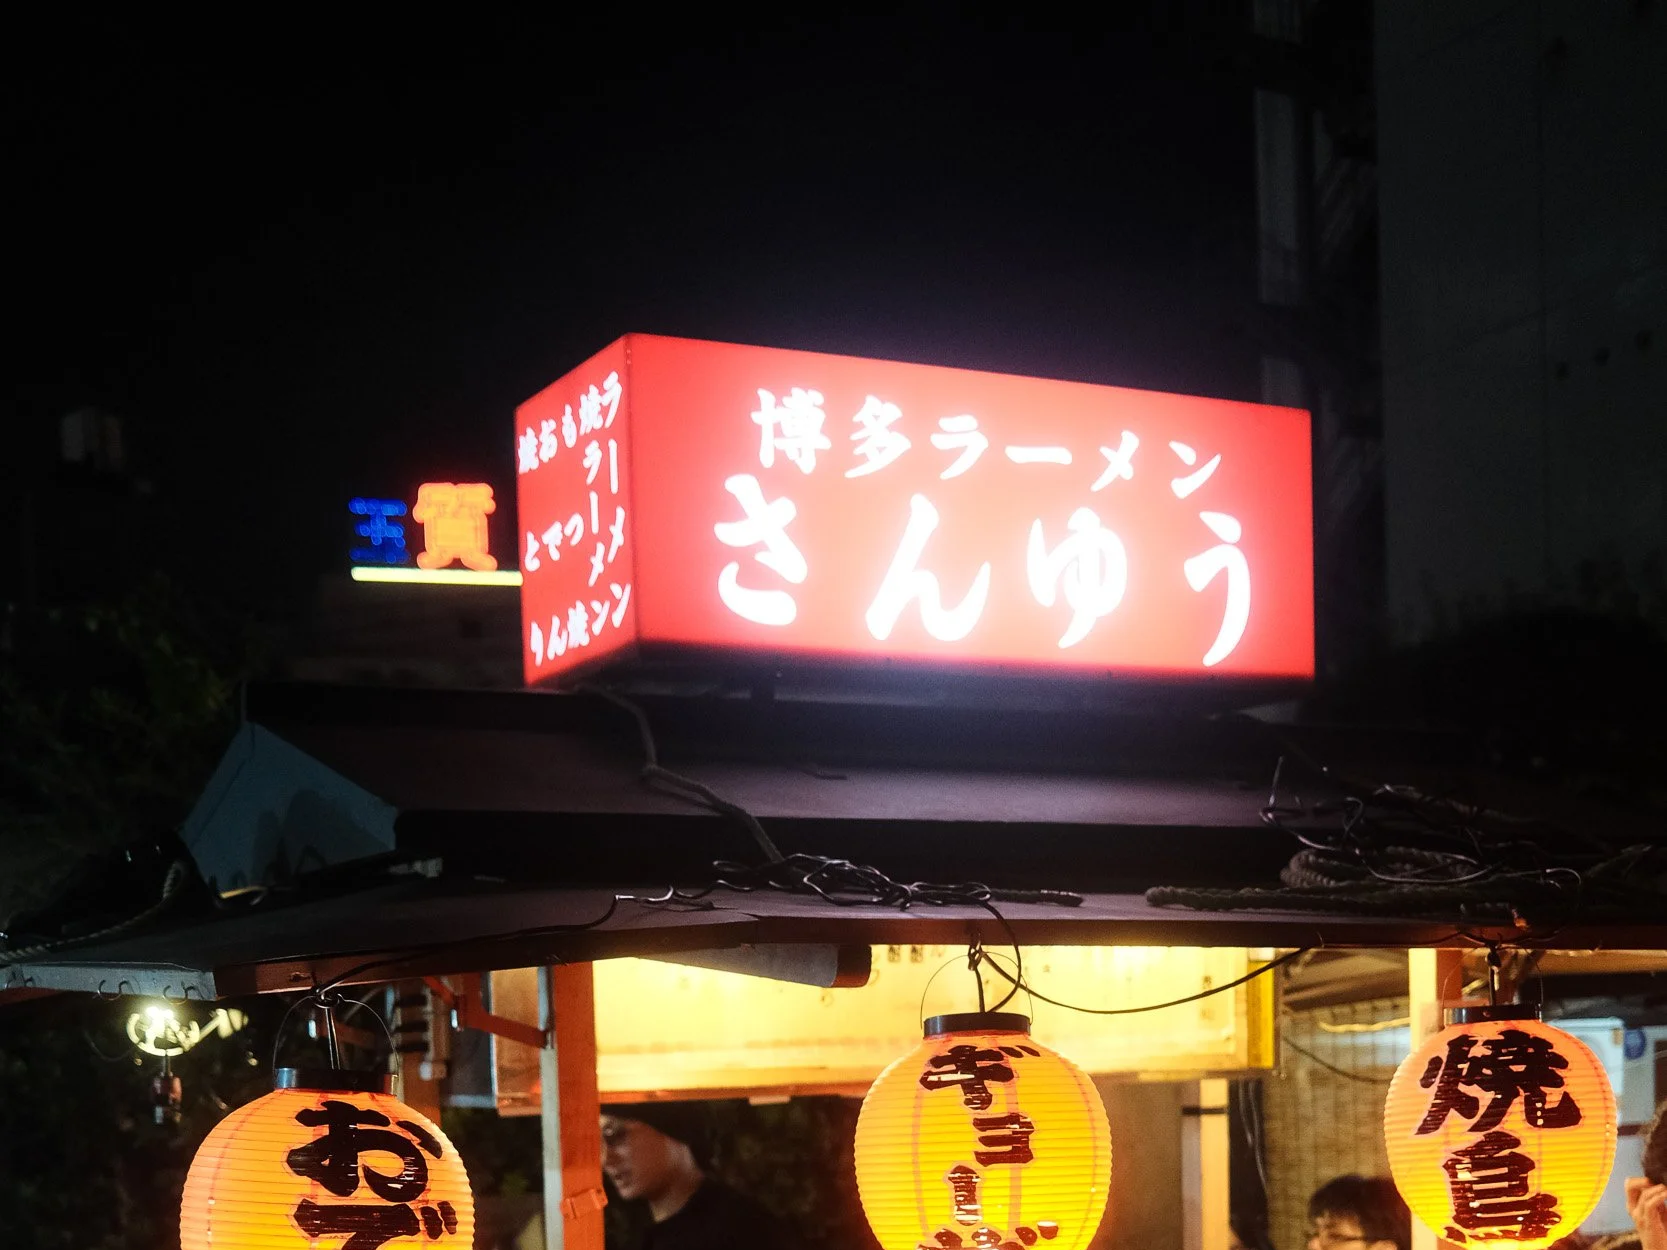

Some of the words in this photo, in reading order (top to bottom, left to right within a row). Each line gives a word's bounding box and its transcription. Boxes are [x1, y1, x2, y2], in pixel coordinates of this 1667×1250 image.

[517, 426, 544, 667] 焼とり
[538, 418, 568, 661] おでん
[579, 384, 611, 636] 焼ラーメン
[600, 370, 631, 628] ラーメン
[750, 387, 1222, 499] 博多ラーメン
[713, 472, 1252, 667] さんゆう
[1414, 1029, 1582, 1244] 焼鳥
